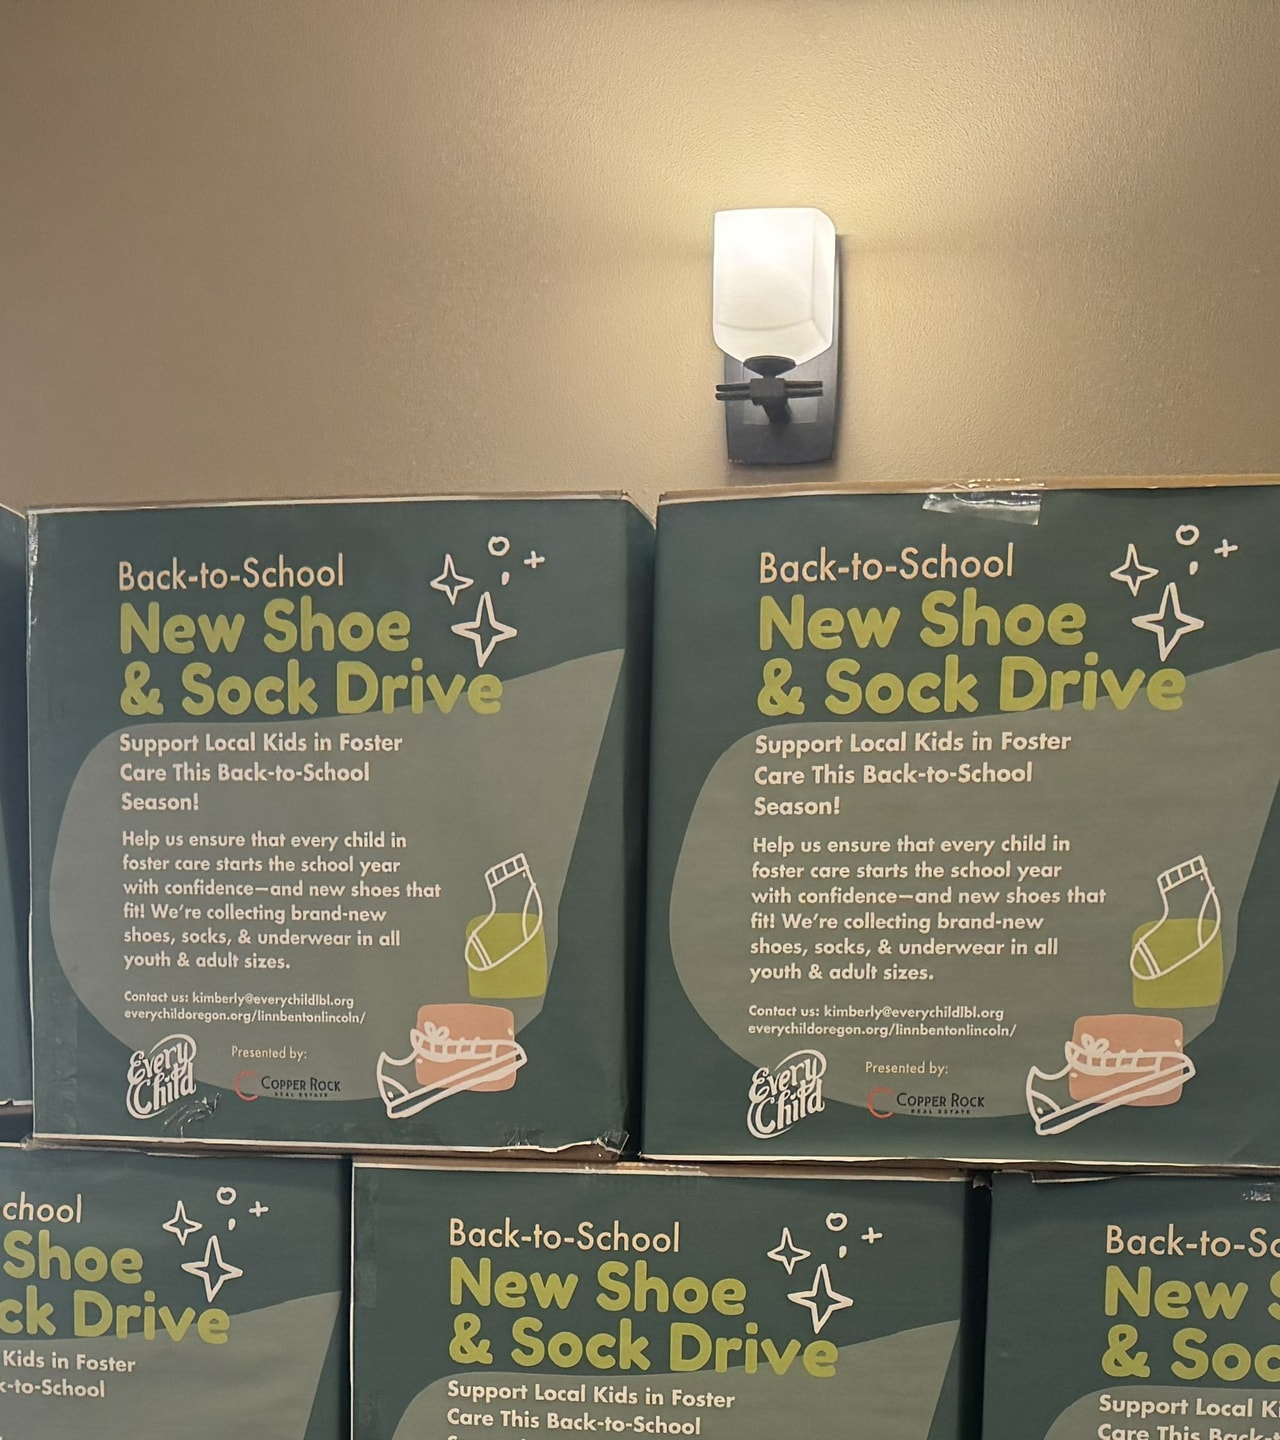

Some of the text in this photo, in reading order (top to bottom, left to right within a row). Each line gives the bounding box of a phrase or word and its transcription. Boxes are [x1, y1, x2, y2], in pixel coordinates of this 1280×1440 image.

[118, 553, 344, 591] Back-to-School
[759, 542, 1013, 583] Back-to-School
[119, 595, 411, 655] New Shoe
[759, 586, 1086, 651] New Shoe
[120, 658, 503, 716] & Sock Drive
[757, 652, 1186, 716] & Sock Drive
[120, 761, 369, 782] Care This Back-to-School
[753, 833, 1070, 857] Help us ensure that every child in
[122, 877, 159, 894] with
[308, 885, 346, 897] new
[351, 880, 400, 897] shoes
[405, 880, 441, 898] that
[747, 1021, 1017, 1038] everychildoregon.org/linnbentonlincoln/
[748, 1004, 1004, 1022] Contact us: kimberly@everychildlbl.org
[748, 1049, 827, 1104] Every
[746, 1077, 825, 1139] Child
[3, 1228, 144, 1284] Shoe
[450, 1216, 679, 1253] Back-to-School
[450, 1257, 746, 1316] New Shoe
[1105, 1265, 1248, 1320] New
[73, 1289, 230, 1345] Drive
[449, 1312, 838, 1379] & Sock Drive
[1102, 1323, 1150, 1378] &
